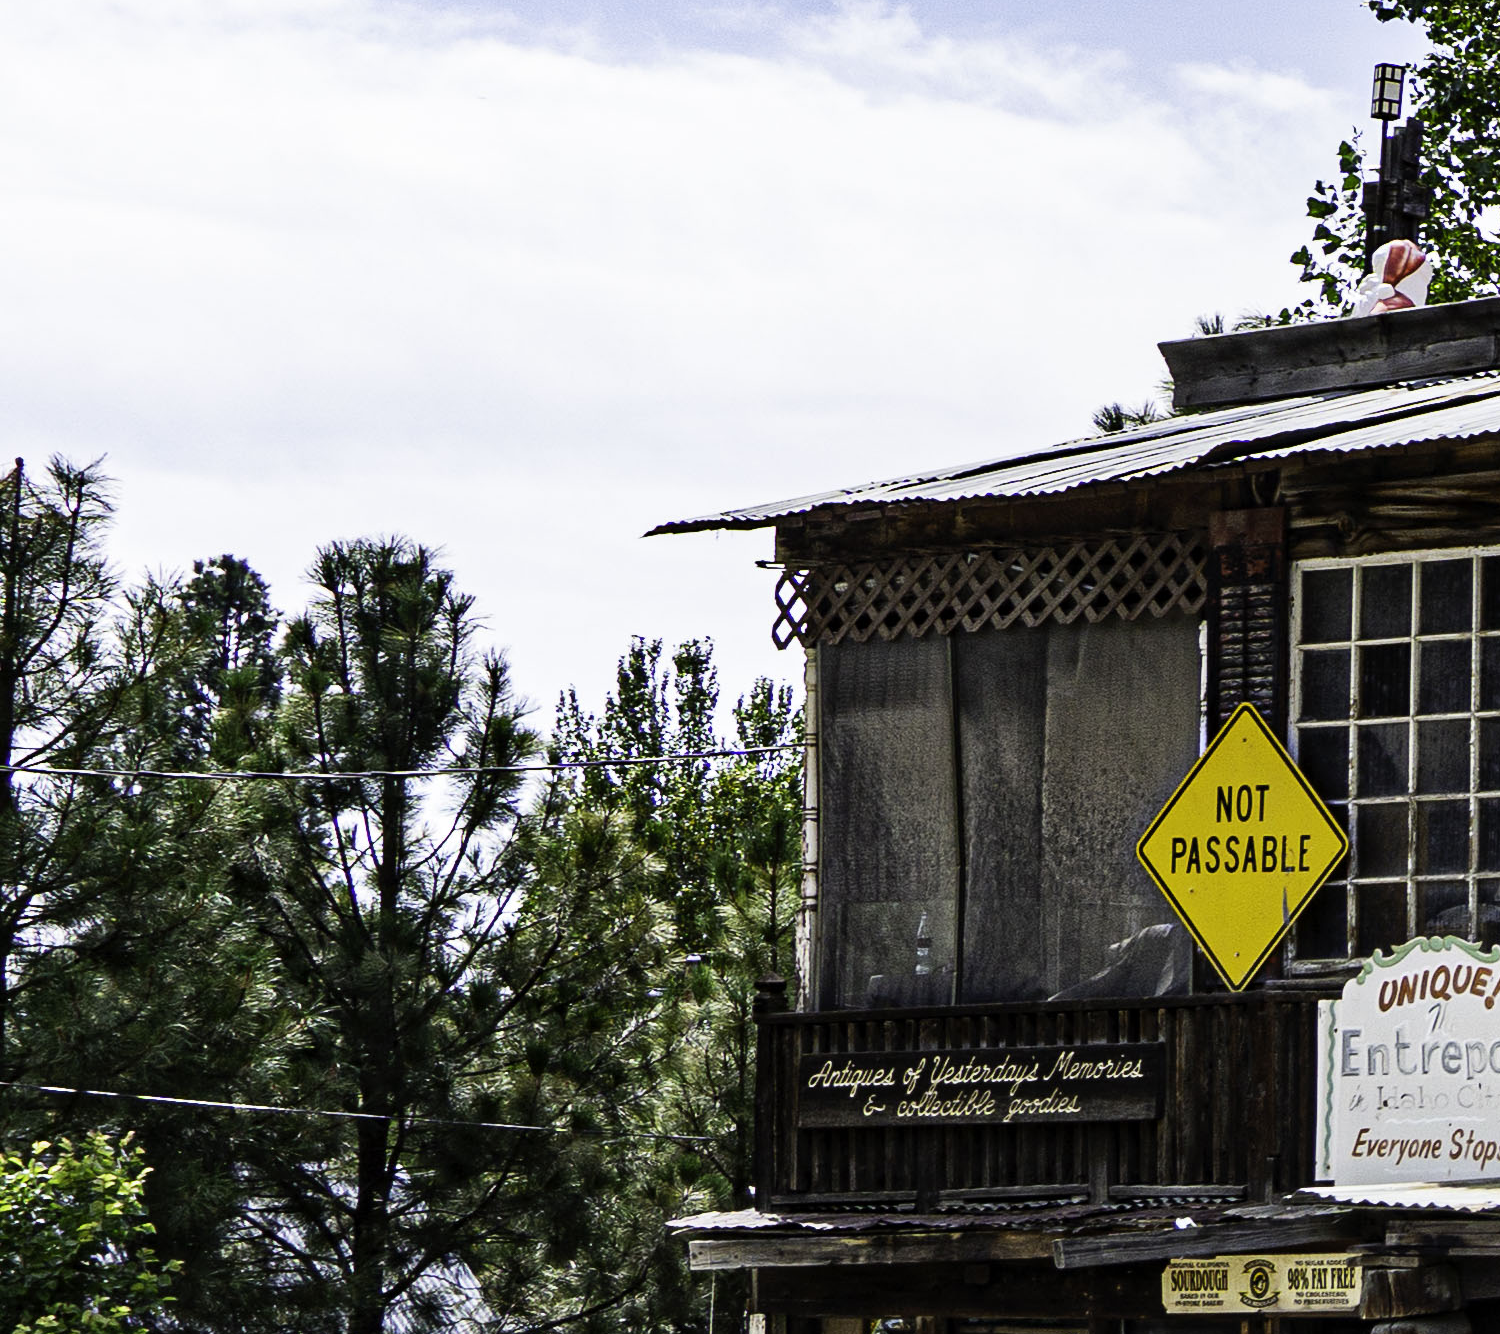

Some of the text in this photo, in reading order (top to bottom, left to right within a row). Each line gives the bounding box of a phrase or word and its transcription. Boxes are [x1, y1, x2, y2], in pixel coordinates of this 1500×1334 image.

[1216, 784, 1270, 823] NOT
[1170, 834, 1312, 874] PASSABLE
[808, 1060, 895, 1097] Antiques
[902, 1057, 925, 1094] of
[1043, 1051, 1144, 1081] Memories
[863, 1088, 1081, 1123] & collectible goodies
[1351, 1128, 1443, 1165] Everyone
[1171, 1269, 1229, 1292] SOURDOUGH
[1287, 1267, 1356, 1290] 98% FAT FREE
